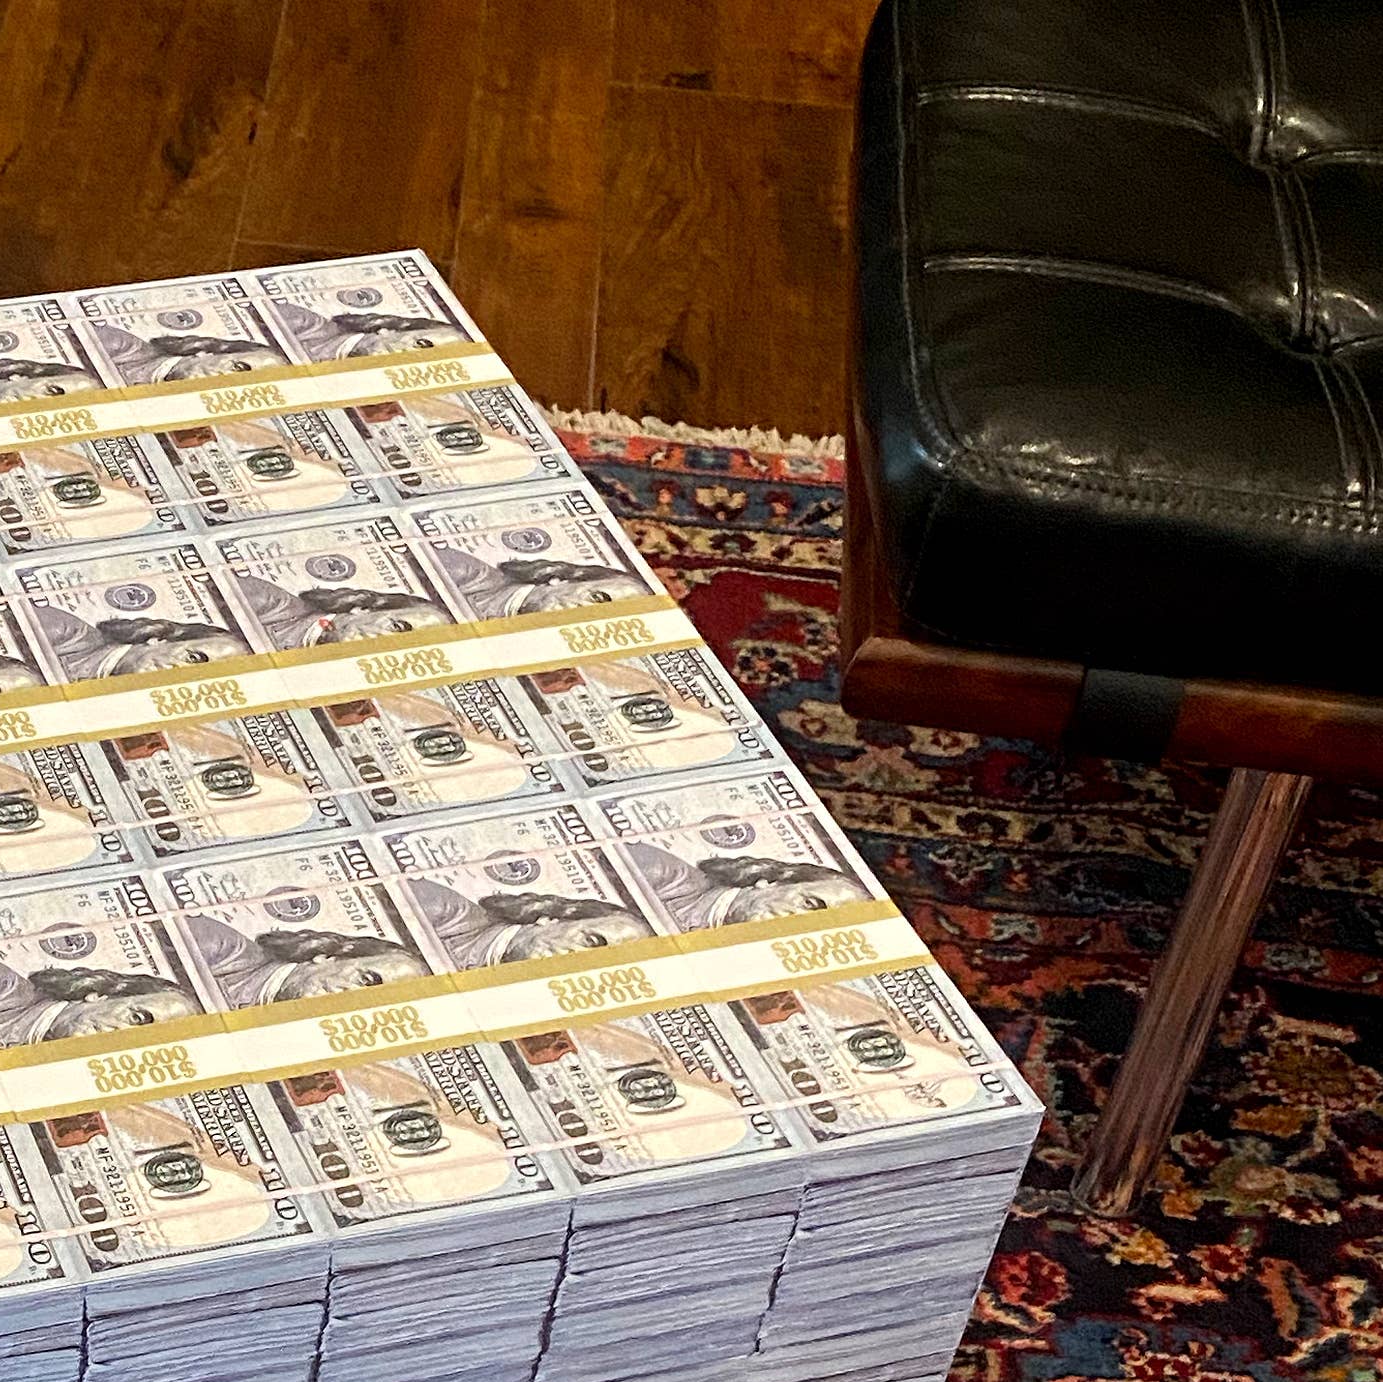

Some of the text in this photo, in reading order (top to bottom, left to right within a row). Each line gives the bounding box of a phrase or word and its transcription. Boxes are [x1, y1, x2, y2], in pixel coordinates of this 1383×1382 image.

[382, 360, 467, 381] $10,000
[387, 368, 473, 389] $10,000
[197, 384, 283, 405] $10,000
[202, 392, 288, 414] $10,000
[8, 408, 95, 430] $10,000
[12, 417, 99, 439] $10,000
[557, 617, 649, 642] $10,000
[564, 627, 657, 653] $10,000
[354, 647, 448, 673] $10,000
[361, 658, 455, 684] $10,000
[148, 679, 243, 705] $10,000
[153, 689, 249, 716] $10,000
[724, 788, 745, 802] F6
[512, 822, 532, 836] F6
[294, 857, 314, 872] F6
[74, 893, 93, 908] F6
[769, 928, 872, 960] $10,000
[777, 941, 881, 973] $10,000
[546, 966, 650, 999] $10,000
[553, 979, 658, 1012] $10,000
[317, 1005, 423, 1039] $10,000
[324, 1018, 431, 1052] $10,000
[85, 1044, 193, 1079] $10,000
[90, 1058, 199, 1092] $10,000
